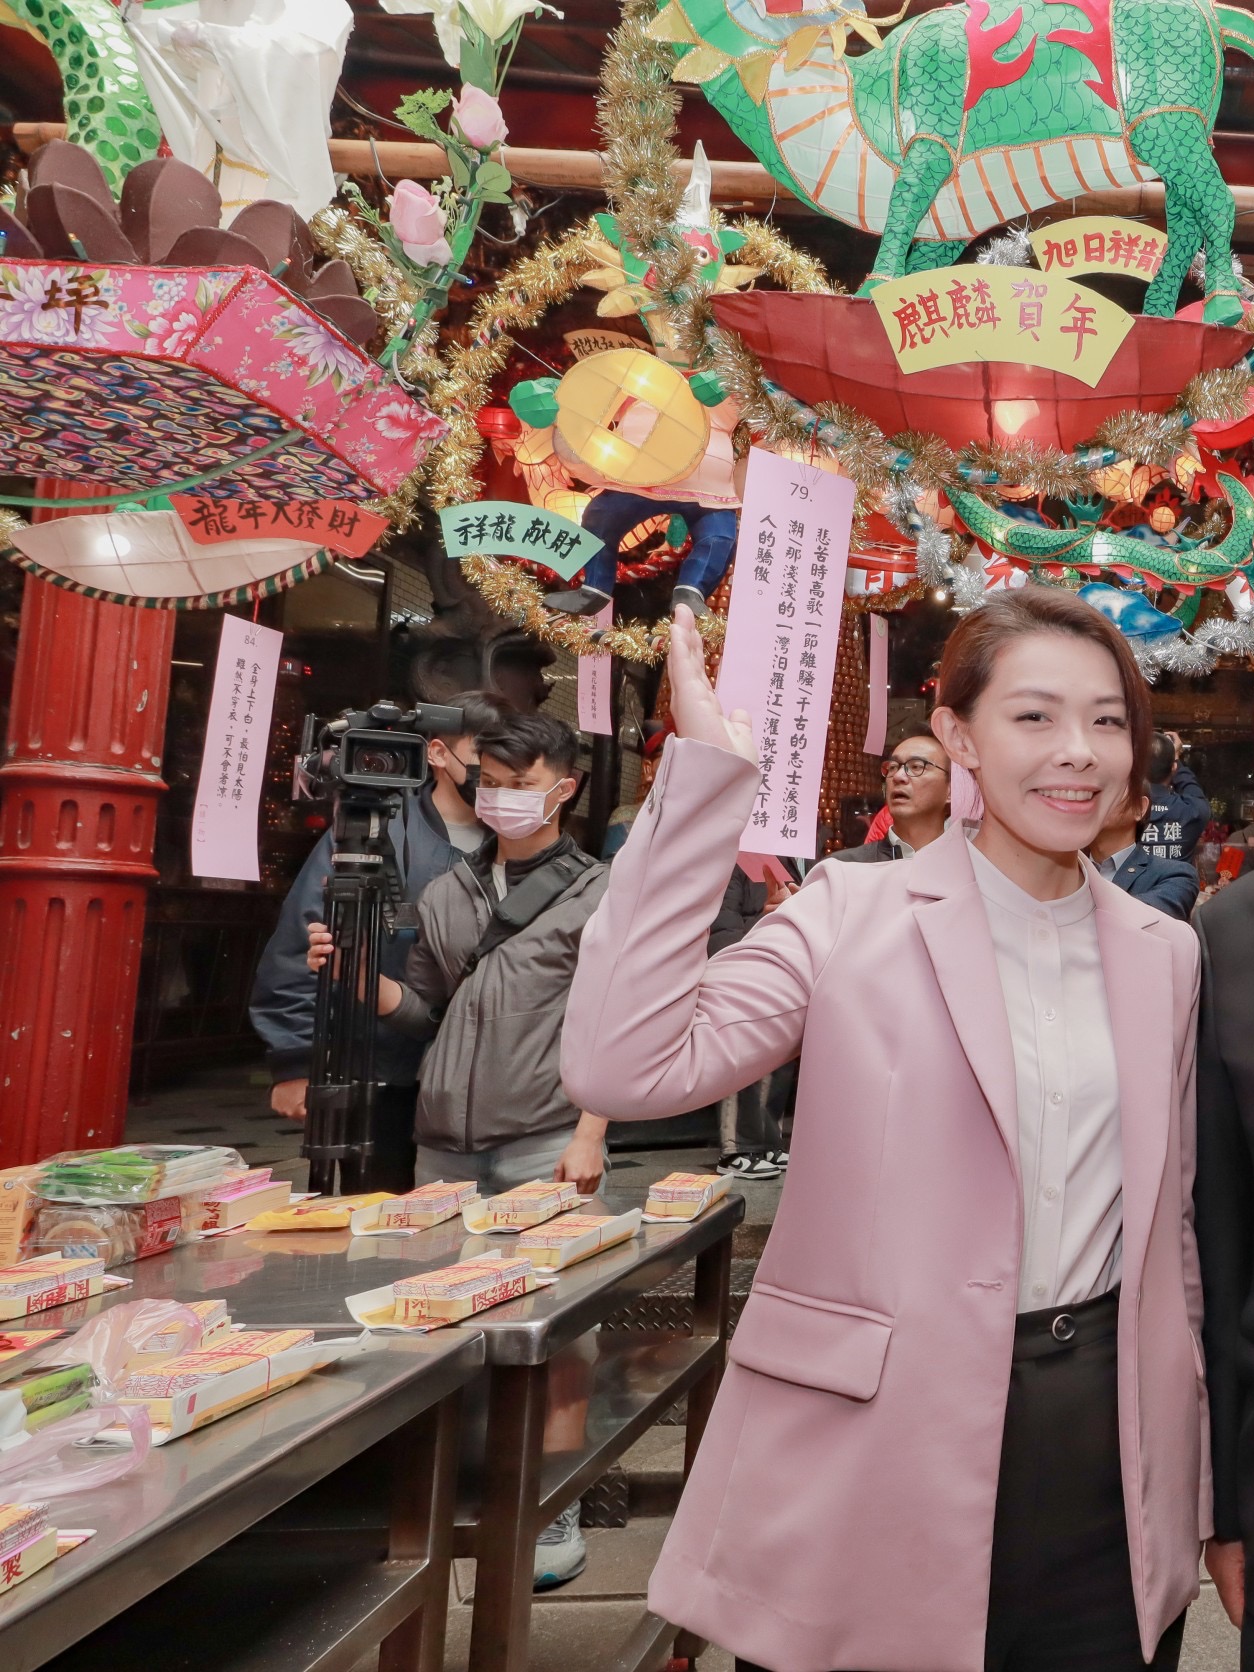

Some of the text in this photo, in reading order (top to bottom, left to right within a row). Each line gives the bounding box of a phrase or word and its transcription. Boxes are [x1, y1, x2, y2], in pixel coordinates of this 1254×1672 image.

[893, 278, 1098, 362] 麒麟賀年
[790, 482, 814, 503] 79.
[189, 499, 360, 537] 龍年大發財
